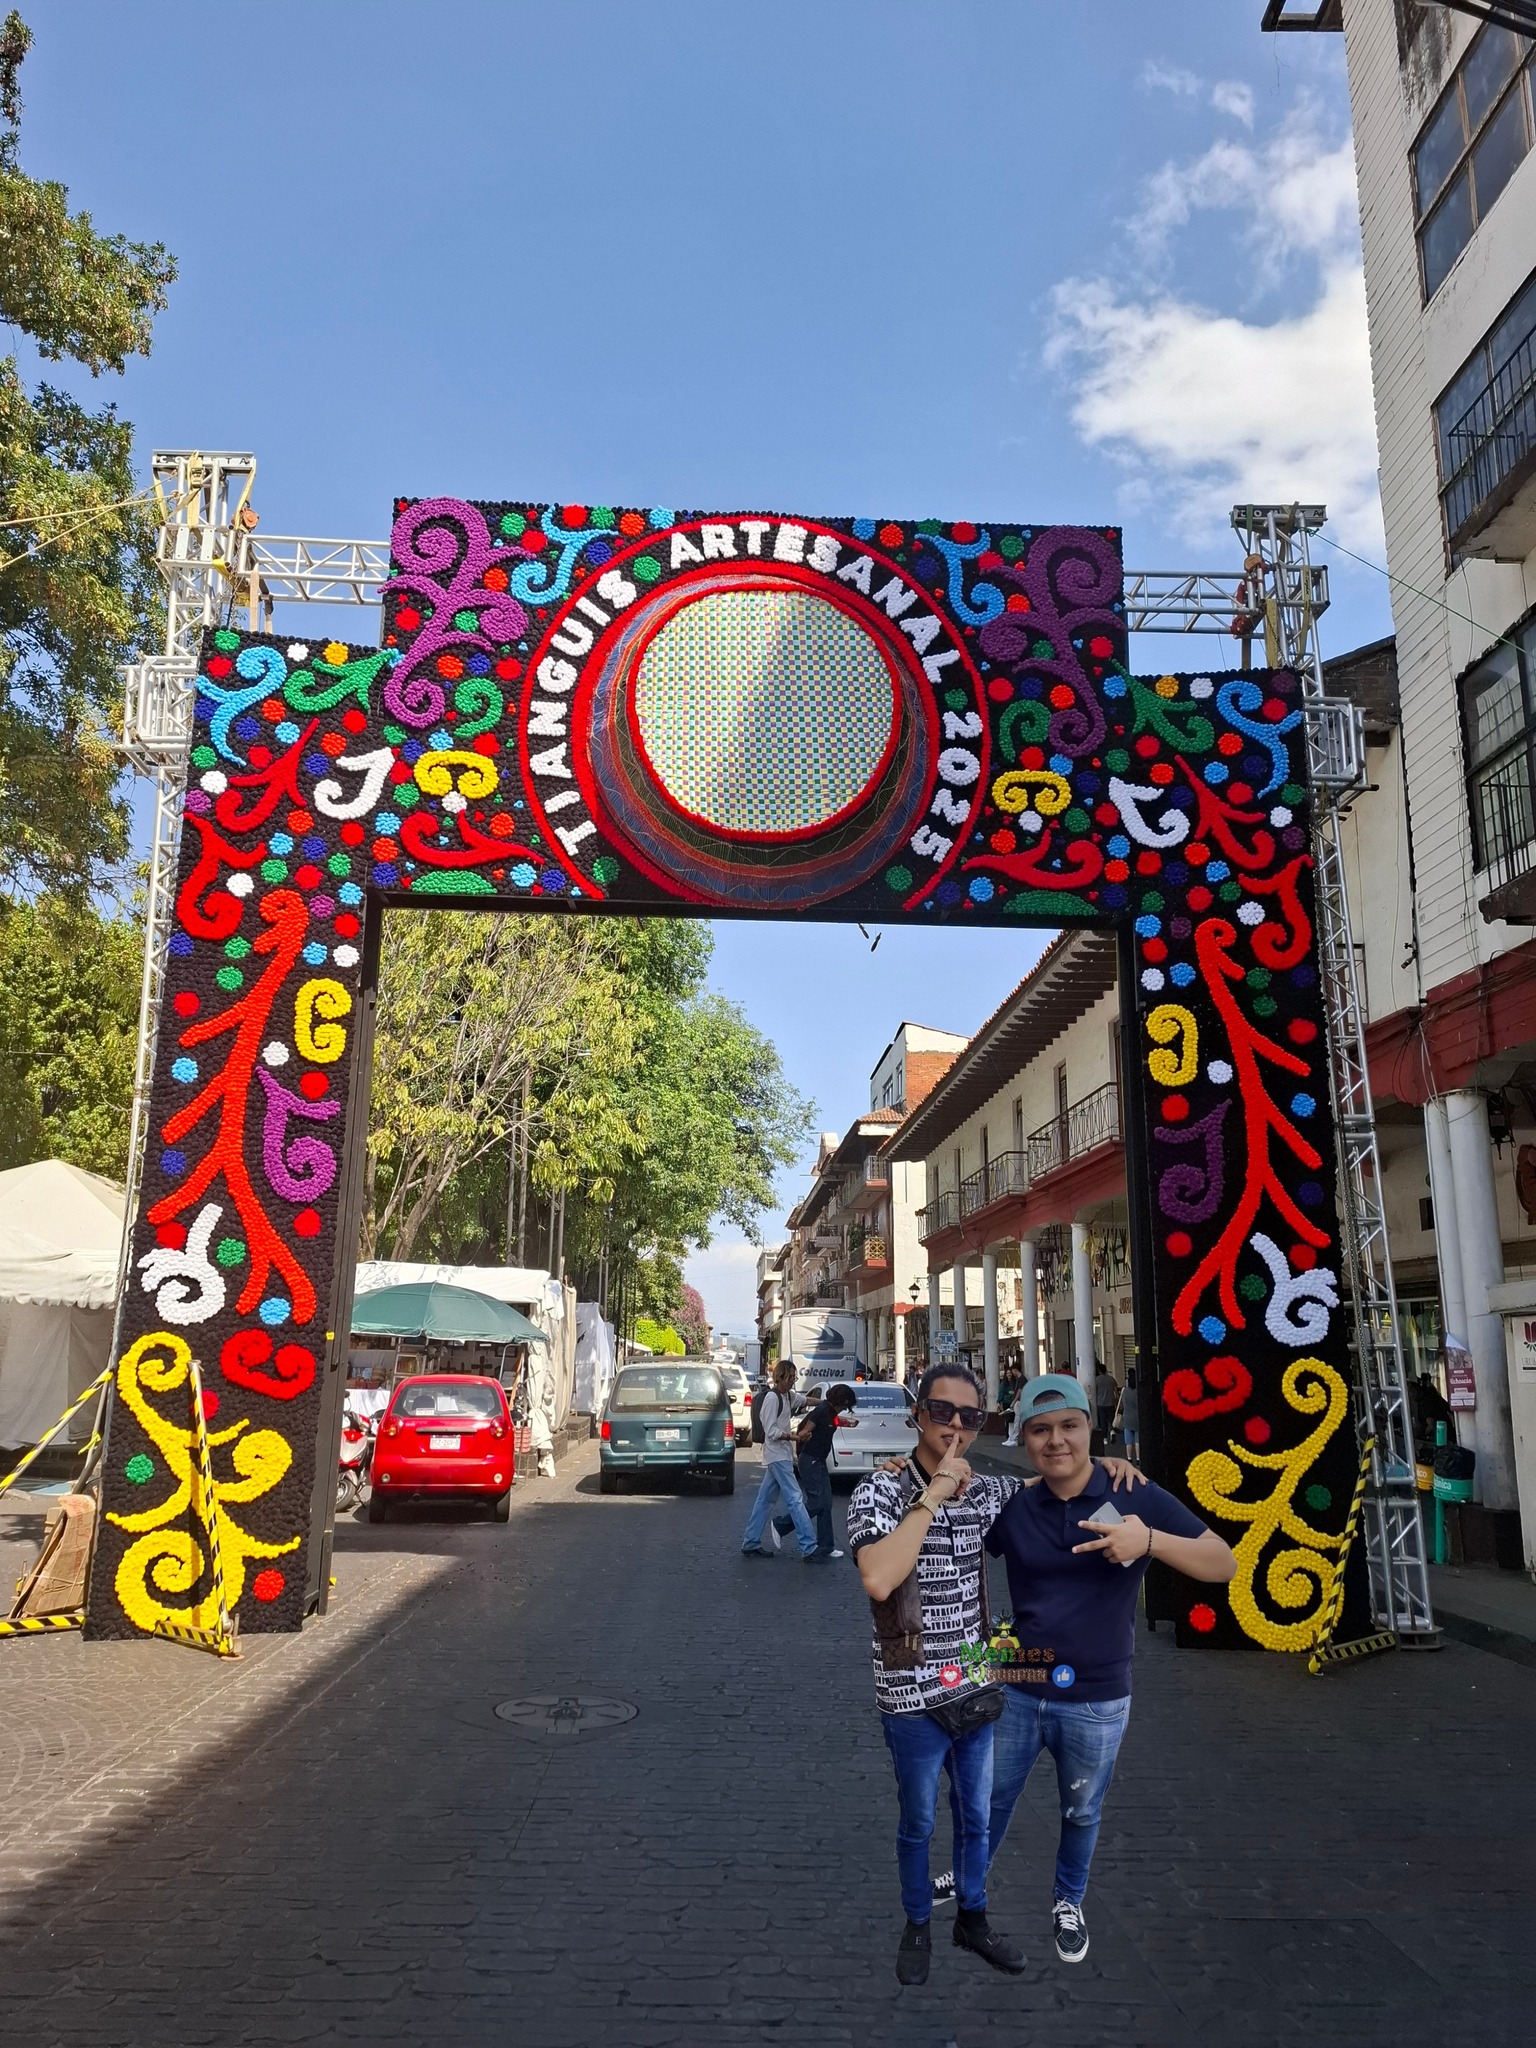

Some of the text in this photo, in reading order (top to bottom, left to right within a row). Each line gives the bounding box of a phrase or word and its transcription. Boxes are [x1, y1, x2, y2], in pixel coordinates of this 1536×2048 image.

[527, 520, 984, 864] TIANGUIS ARTESANAL 2025
[799, 1367, 846, 1378] Colectivos
[918, 1558, 958, 1579] ENNIS
[922, 1605, 961, 1630] ENNIS
